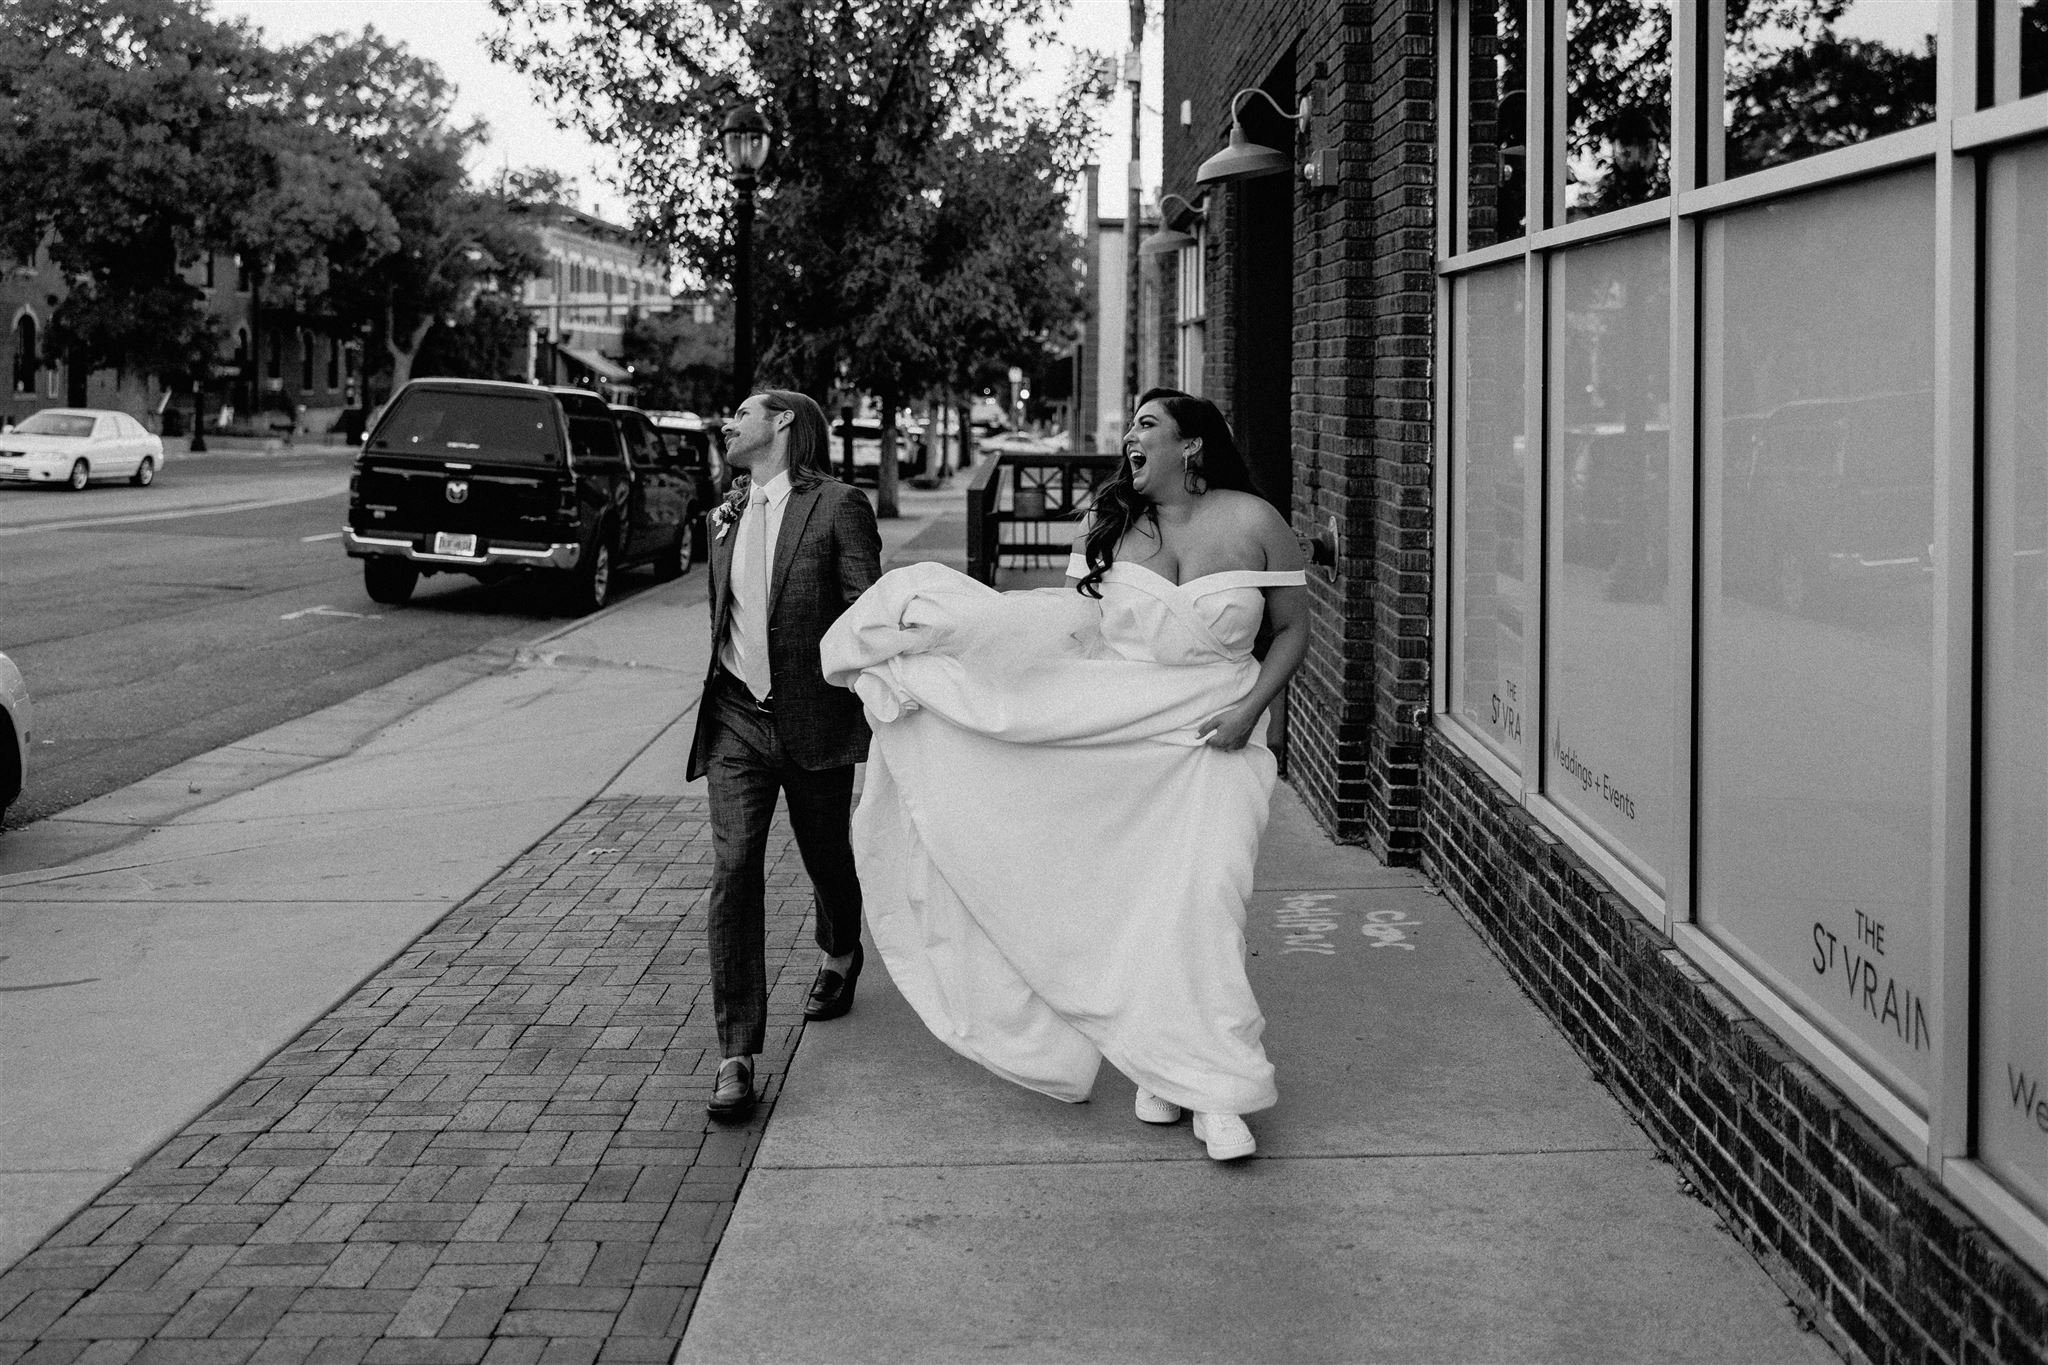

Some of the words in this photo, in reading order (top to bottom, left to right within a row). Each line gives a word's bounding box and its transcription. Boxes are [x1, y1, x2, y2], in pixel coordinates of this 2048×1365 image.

[1506, 679, 1517, 702] THE
[1603, 773, 1635, 820] Events
[1855, 908, 1885, 956] THE
[1813, 922, 1837, 975] ST
[1843, 945, 1930, 1053] VRAIN
[2007, 1062, 2048, 1133] We
